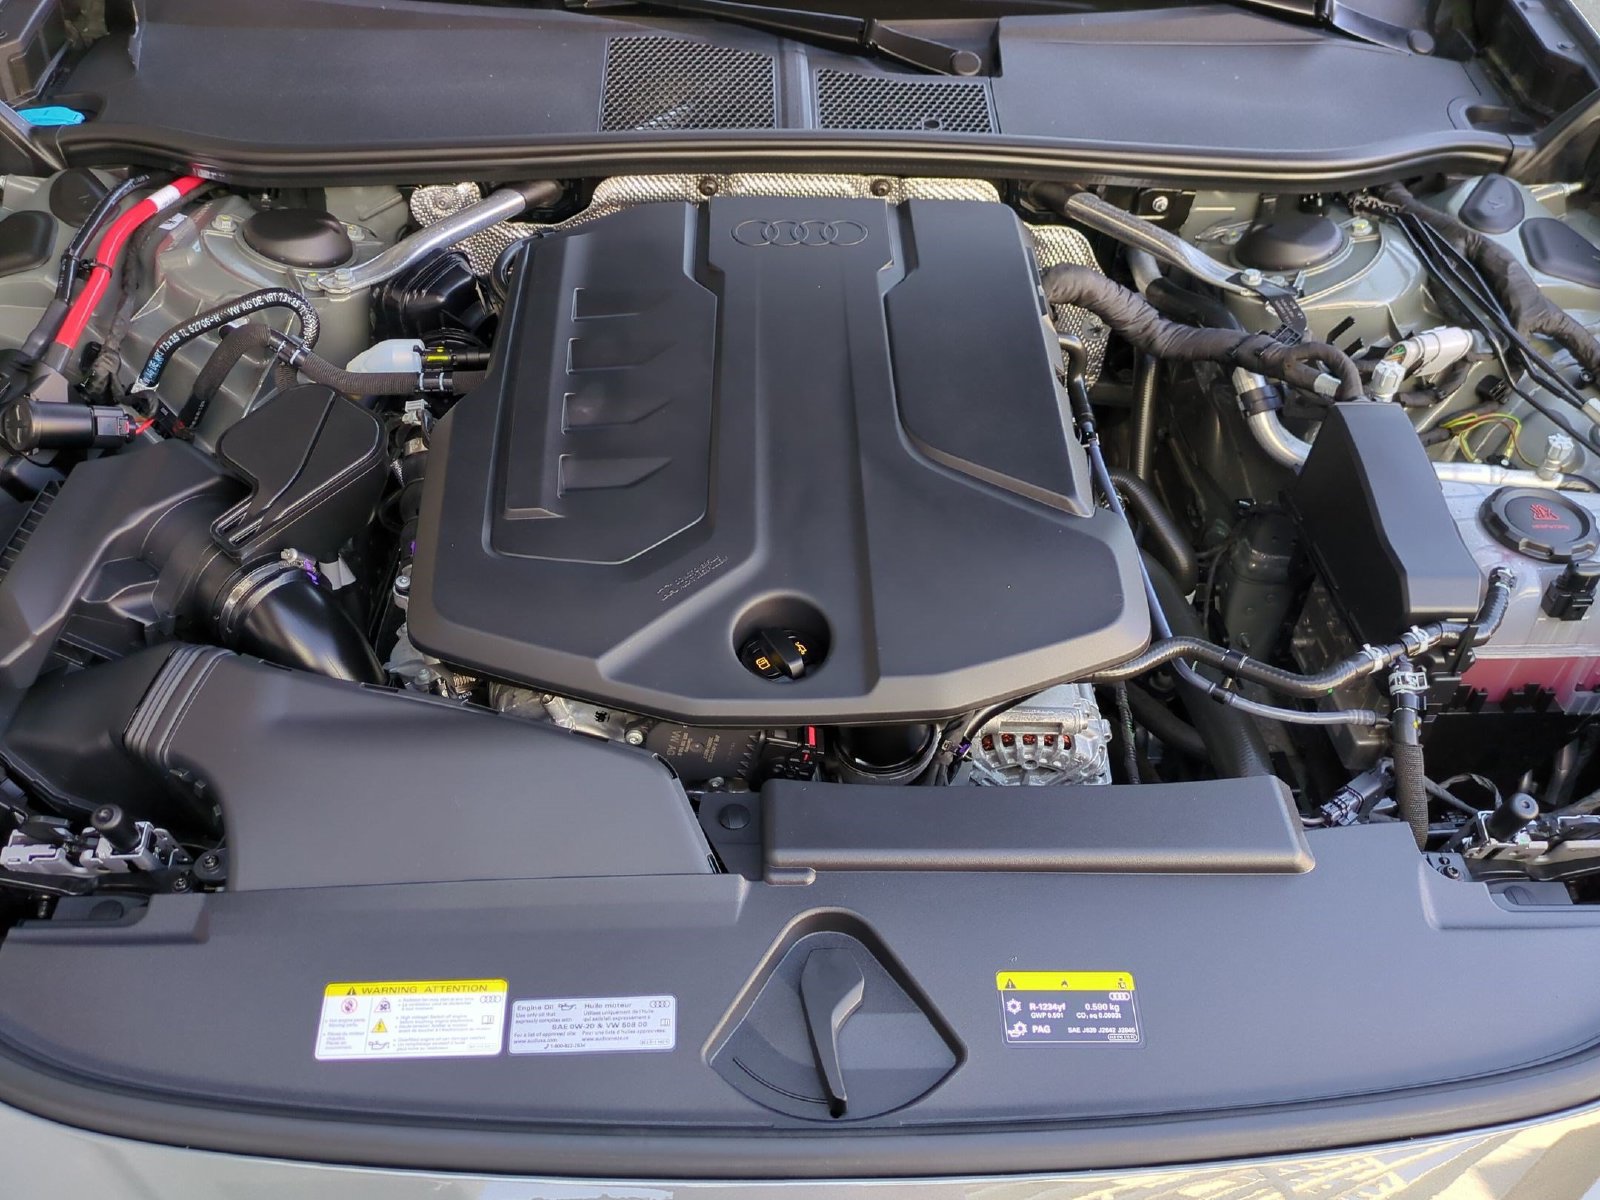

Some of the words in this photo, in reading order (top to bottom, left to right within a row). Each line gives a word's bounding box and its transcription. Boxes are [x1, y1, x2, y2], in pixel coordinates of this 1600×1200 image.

[362, 985, 418, 994] WARNING
[424, 984, 488, 993] ATTENTION
[517, 1004, 542, 1012] Engine
[1029, 1002, 1066, 1012] R-1234yf
[1109, 1002, 1120, 1012] kg
[1032, 1025, 1051, 1034] PAG
